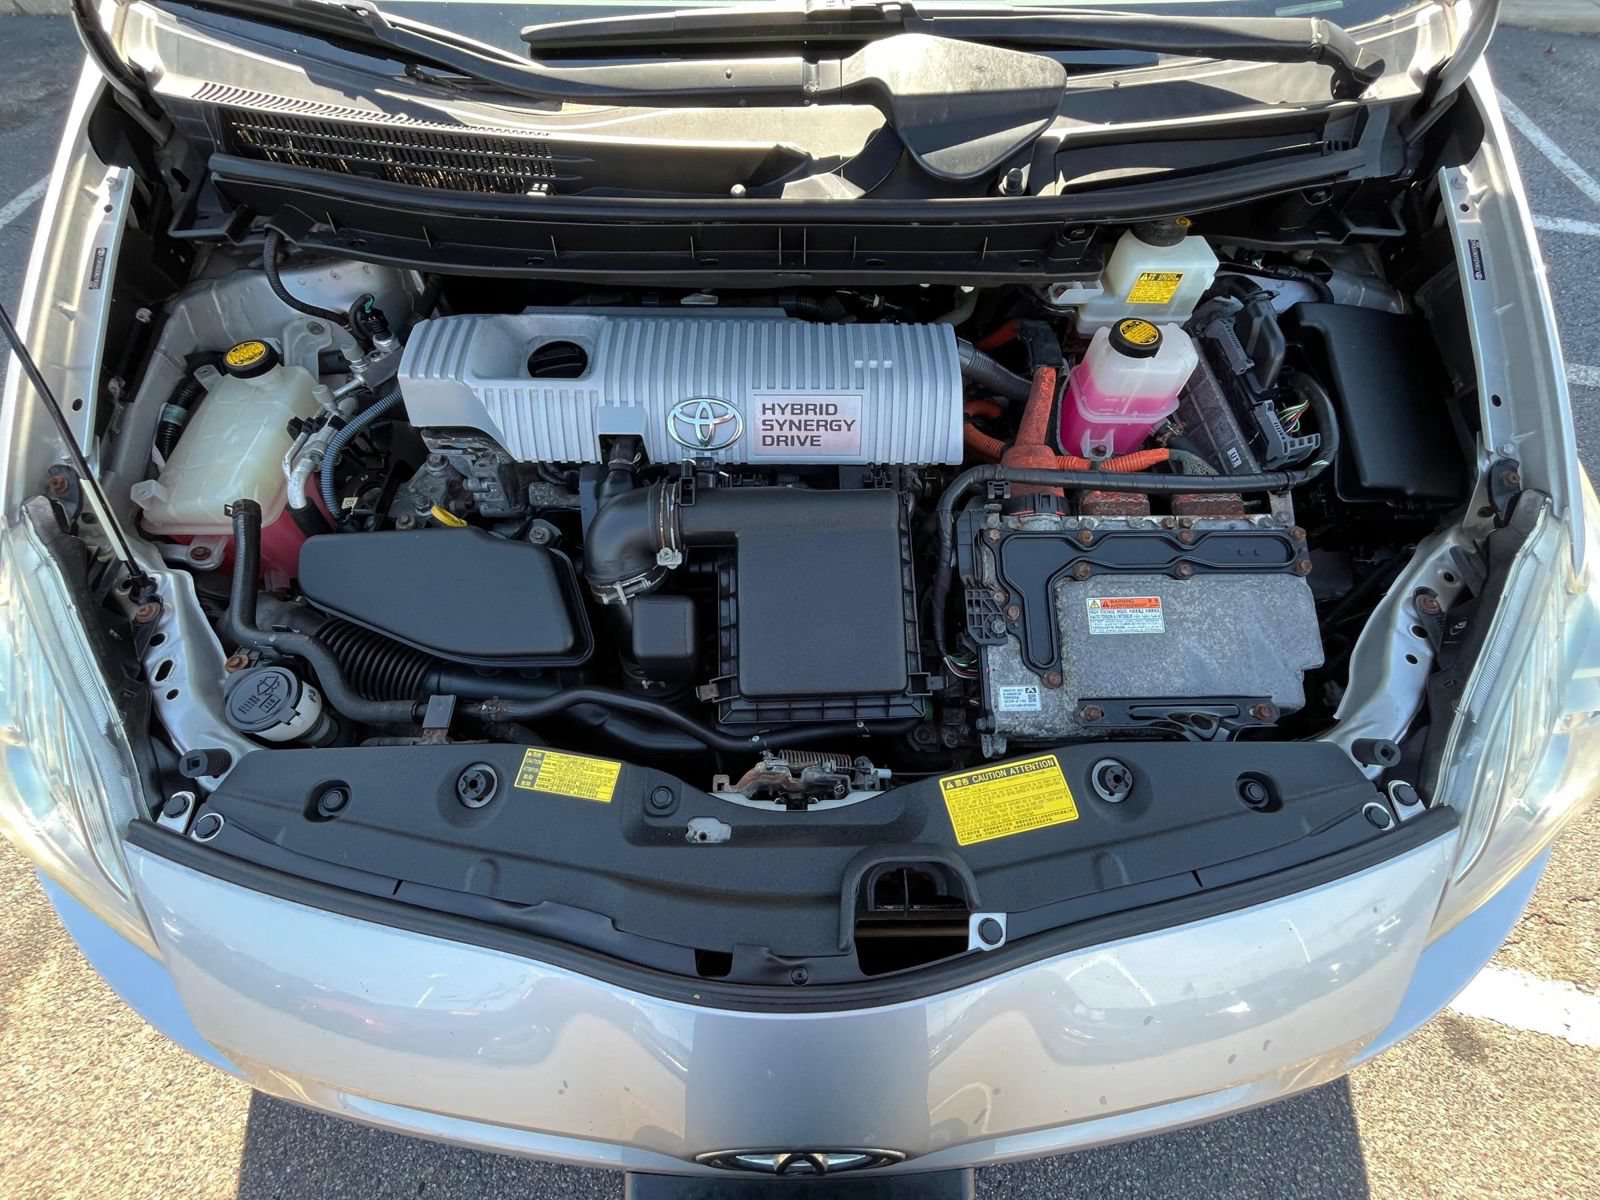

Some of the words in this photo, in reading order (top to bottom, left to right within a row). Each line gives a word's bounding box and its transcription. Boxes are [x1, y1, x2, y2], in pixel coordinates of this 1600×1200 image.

[761, 403, 838, 416] HYBRID
[761, 419, 857, 432] SYNERGY
[761, 434, 822, 447] DRIVE
[972, 769, 1008, 783] CAUTION
[1010, 759, 1055, 776] ATTENTION
